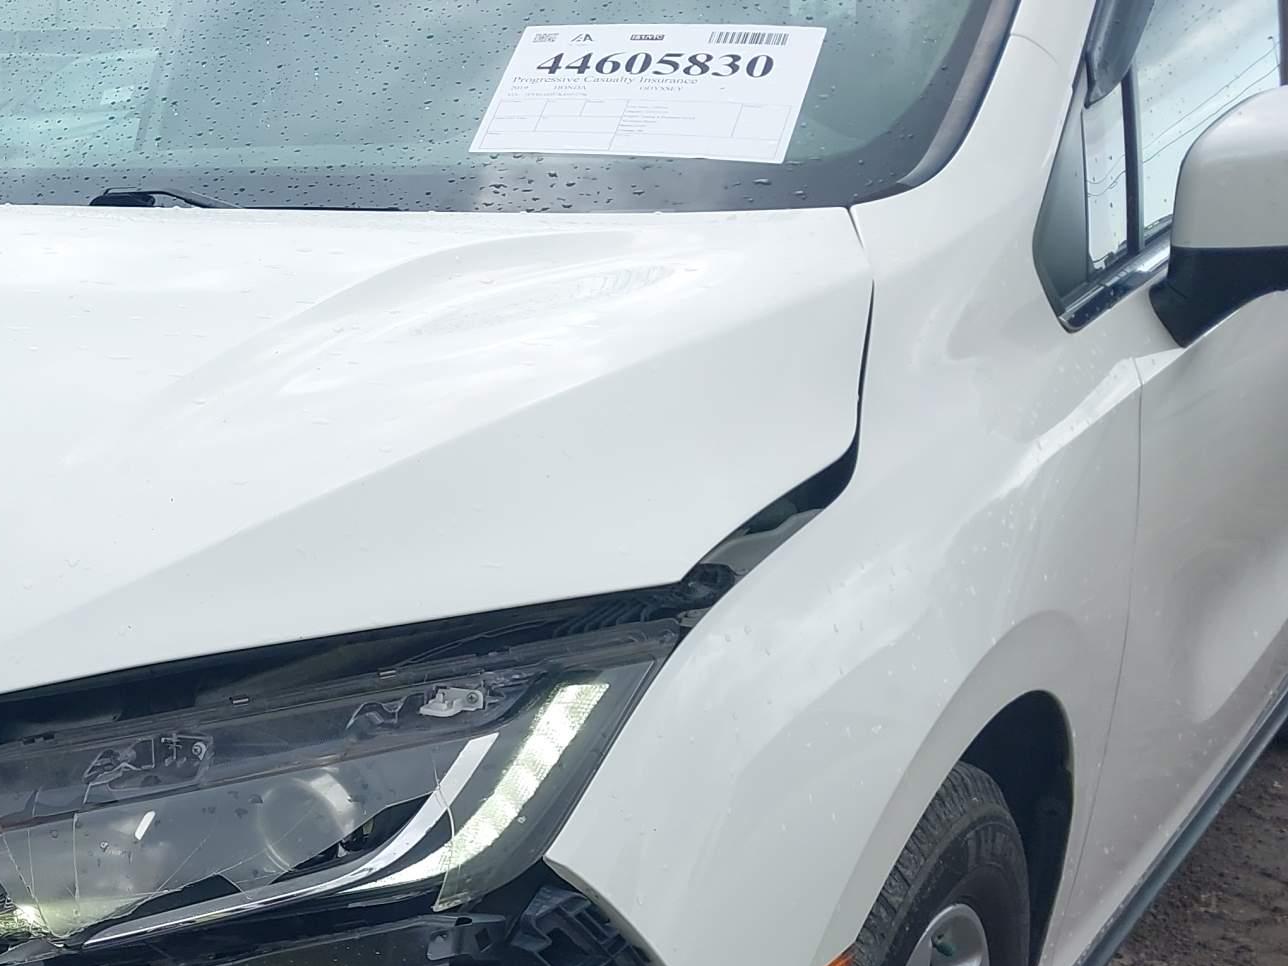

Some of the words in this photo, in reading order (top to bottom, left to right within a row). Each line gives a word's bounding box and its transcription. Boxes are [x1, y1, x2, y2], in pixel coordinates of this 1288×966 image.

[537, 51, 774, 78] 44605830
[512, 76, 580, 84] Progressive
[583, 76, 633, 84] Casualty
[639, 76, 698, 85] Insurance
